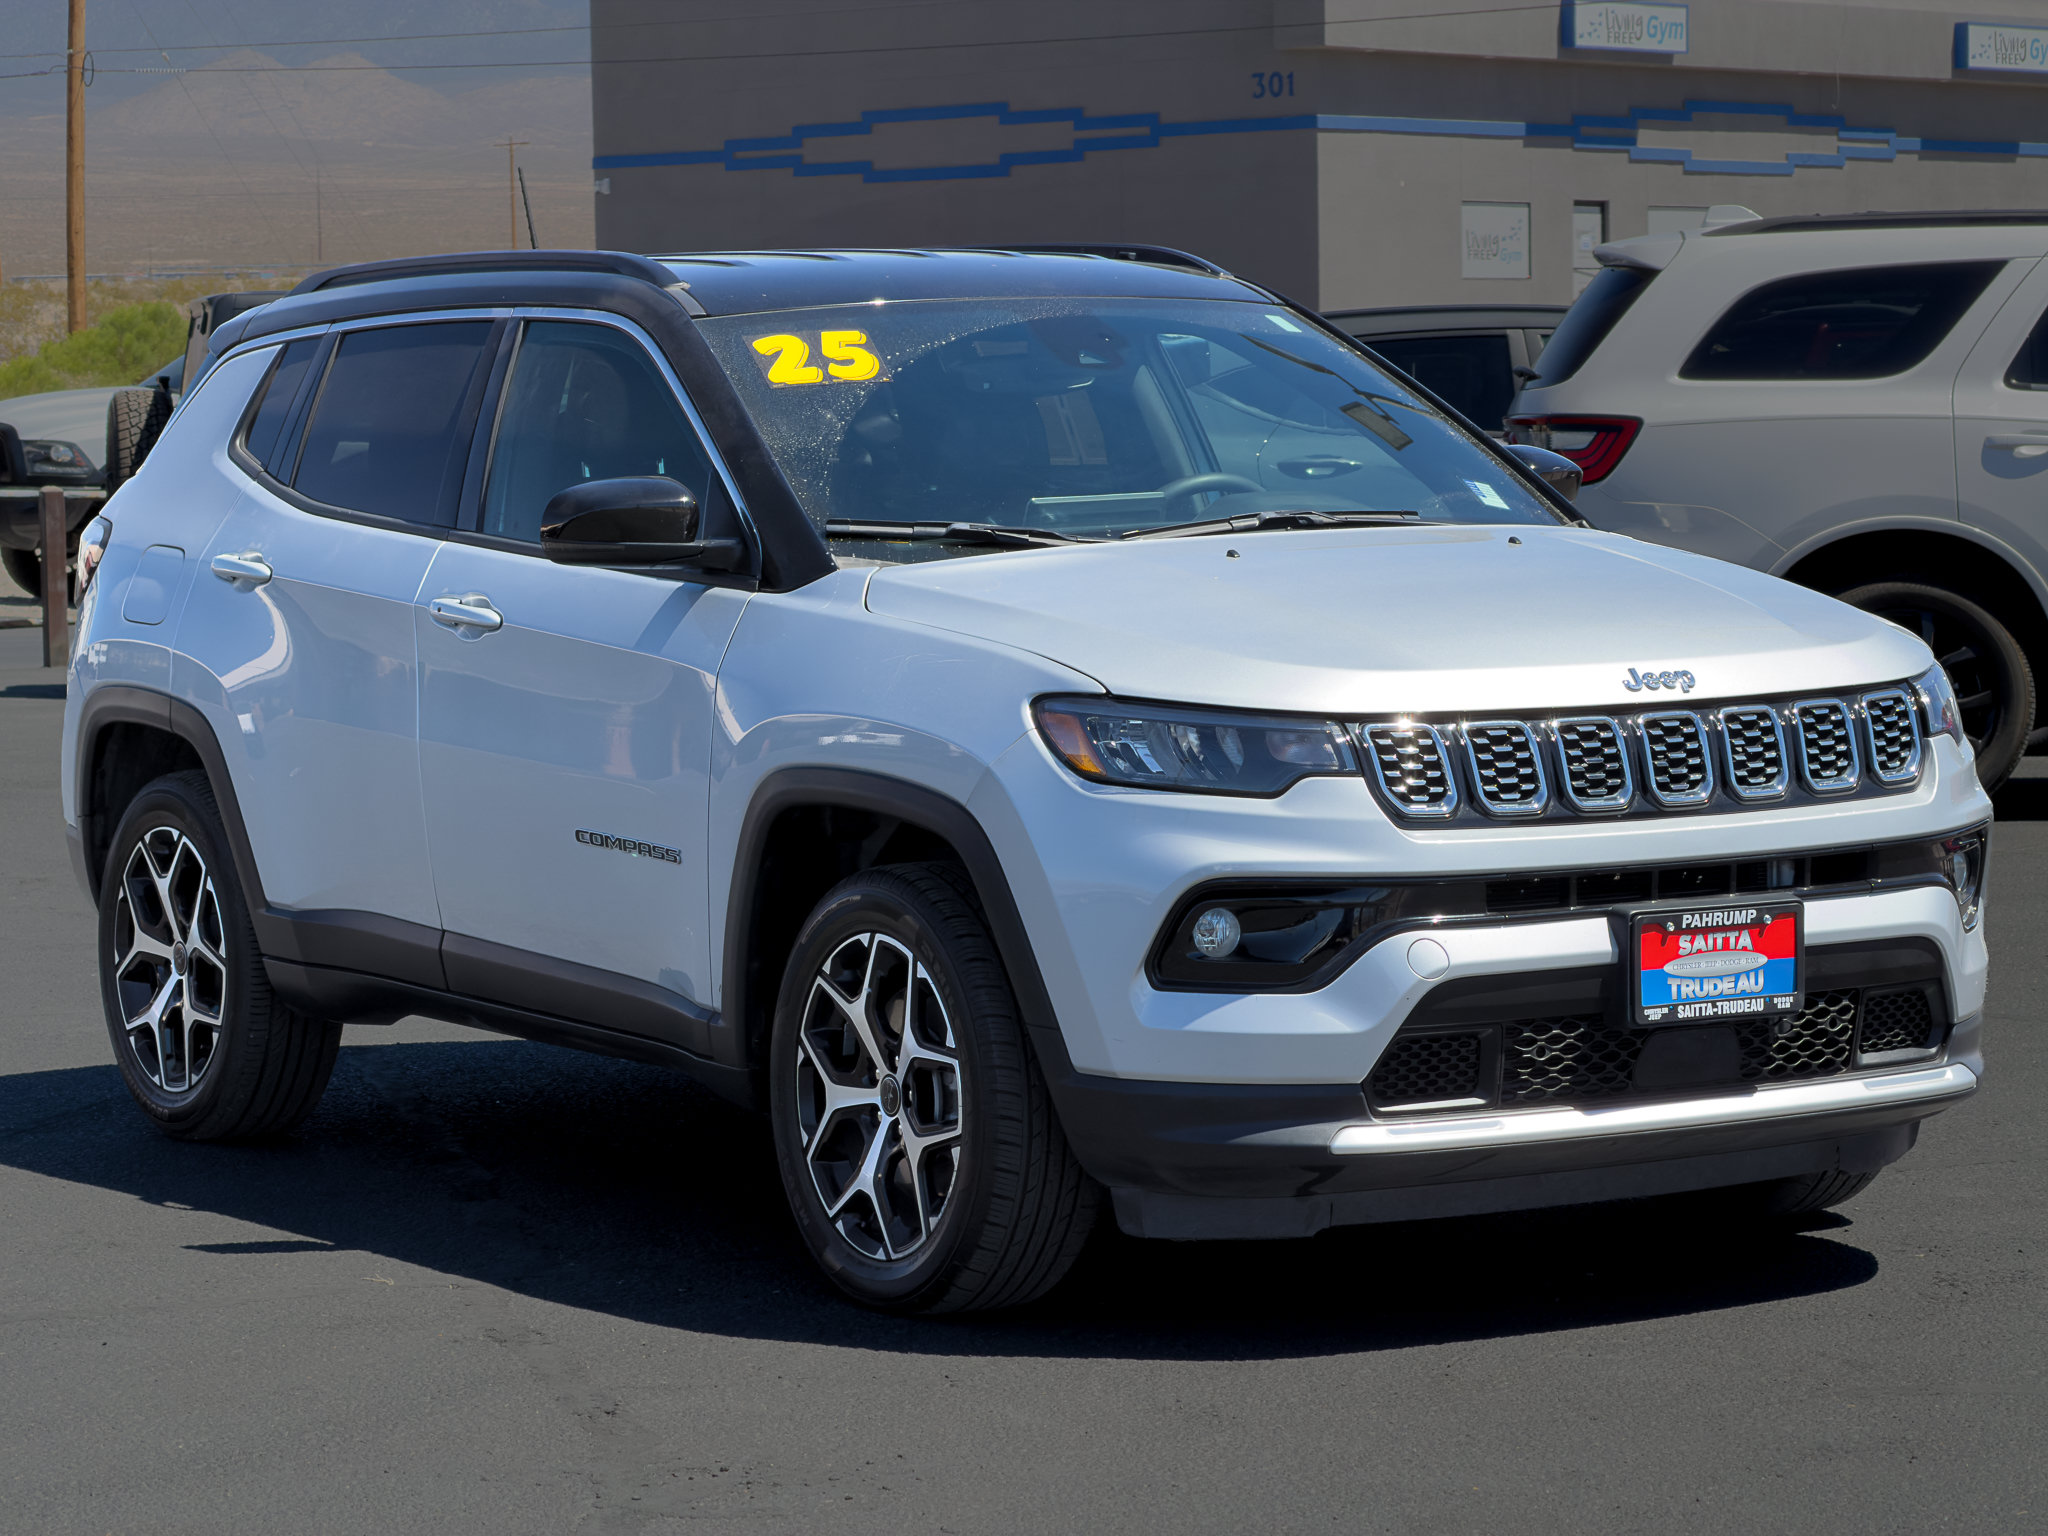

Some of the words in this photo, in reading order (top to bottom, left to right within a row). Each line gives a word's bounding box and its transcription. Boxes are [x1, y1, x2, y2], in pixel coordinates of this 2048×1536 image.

[1604, 8, 1643, 41] Living
[1646, 15, 1685, 44] Gym
[1606, 31, 1635, 44] FREE
[1994, 30, 2027, 62] Living
[2030, 38, 2048, 65] Gy
[1995, 52, 2021, 65] FREE
[1251, 71, 1295, 99] 301
[1467, 248, 1493, 261] FREE
[752, 330, 880, 385] 25
[1622, 667, 1696, 694] Jeep
[575, 827, 682, 865] COMPASS
[1682, 909, 1757, 928] PAHRUMP
[1678, 929, 1754, 956] SAITTA
[1672, 961, 1702, 971] CHRYSLER
[1720, 958, 1743, 967] DODGE
[1745, 956, 1760, 965] RAM
[1667, 969, 1764, 1001] TRUDEAU
[1647, 1013, 1662, 1021] JEEP
[1677, 998, 1764, 1019] SAITTA-TRUDEAU
